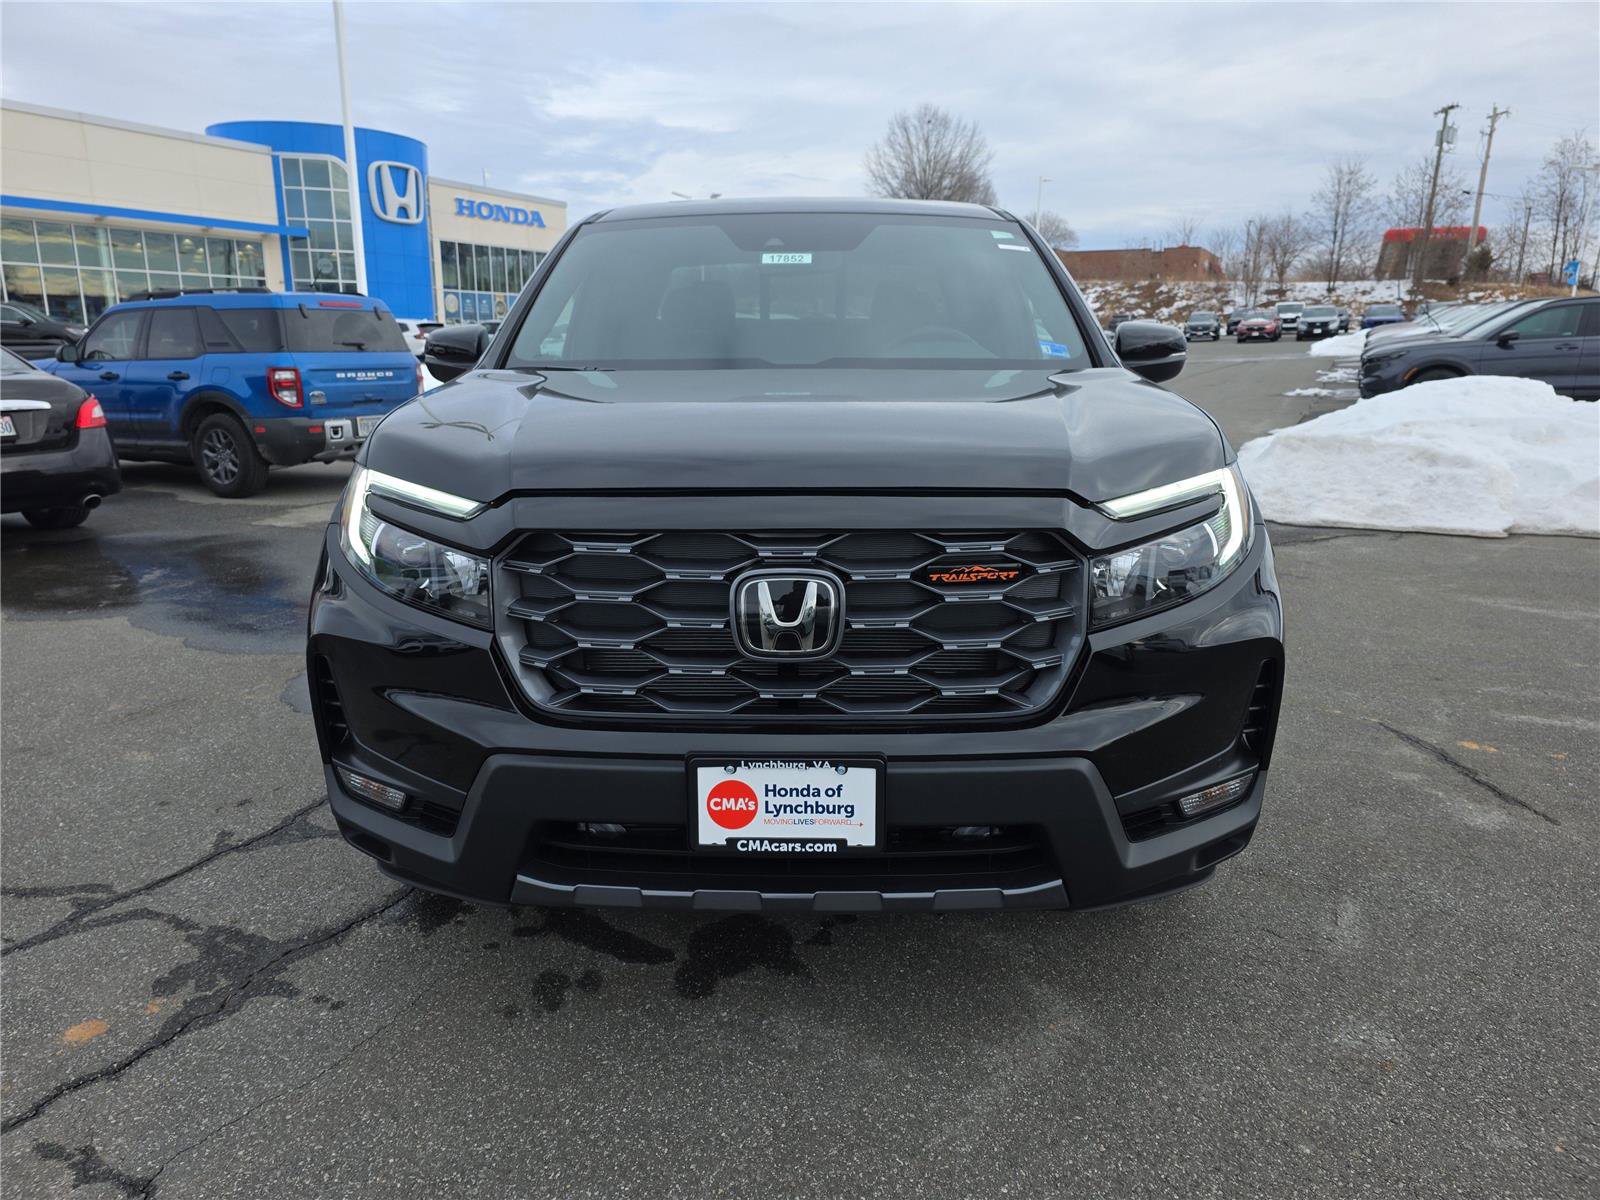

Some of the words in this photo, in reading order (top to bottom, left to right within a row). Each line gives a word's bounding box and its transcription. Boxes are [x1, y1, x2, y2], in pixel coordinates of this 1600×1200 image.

[454, 197, 546, 228] HONDA
[770, 254, 804, 263] 17852
[929, 570, 1019, 583] TRAILSPORT
[741, 760, 810, 771] Lynchburg,
[813, 760, 832, 770] VA
[764, 783, 821, 798] Honda
[824, 783, 844, 798] of
[709, 797, 756, 812] CMA's
[764, 800, 856, 818] Lynchburg
[736, 839, 838, 853] CMAcars.com
